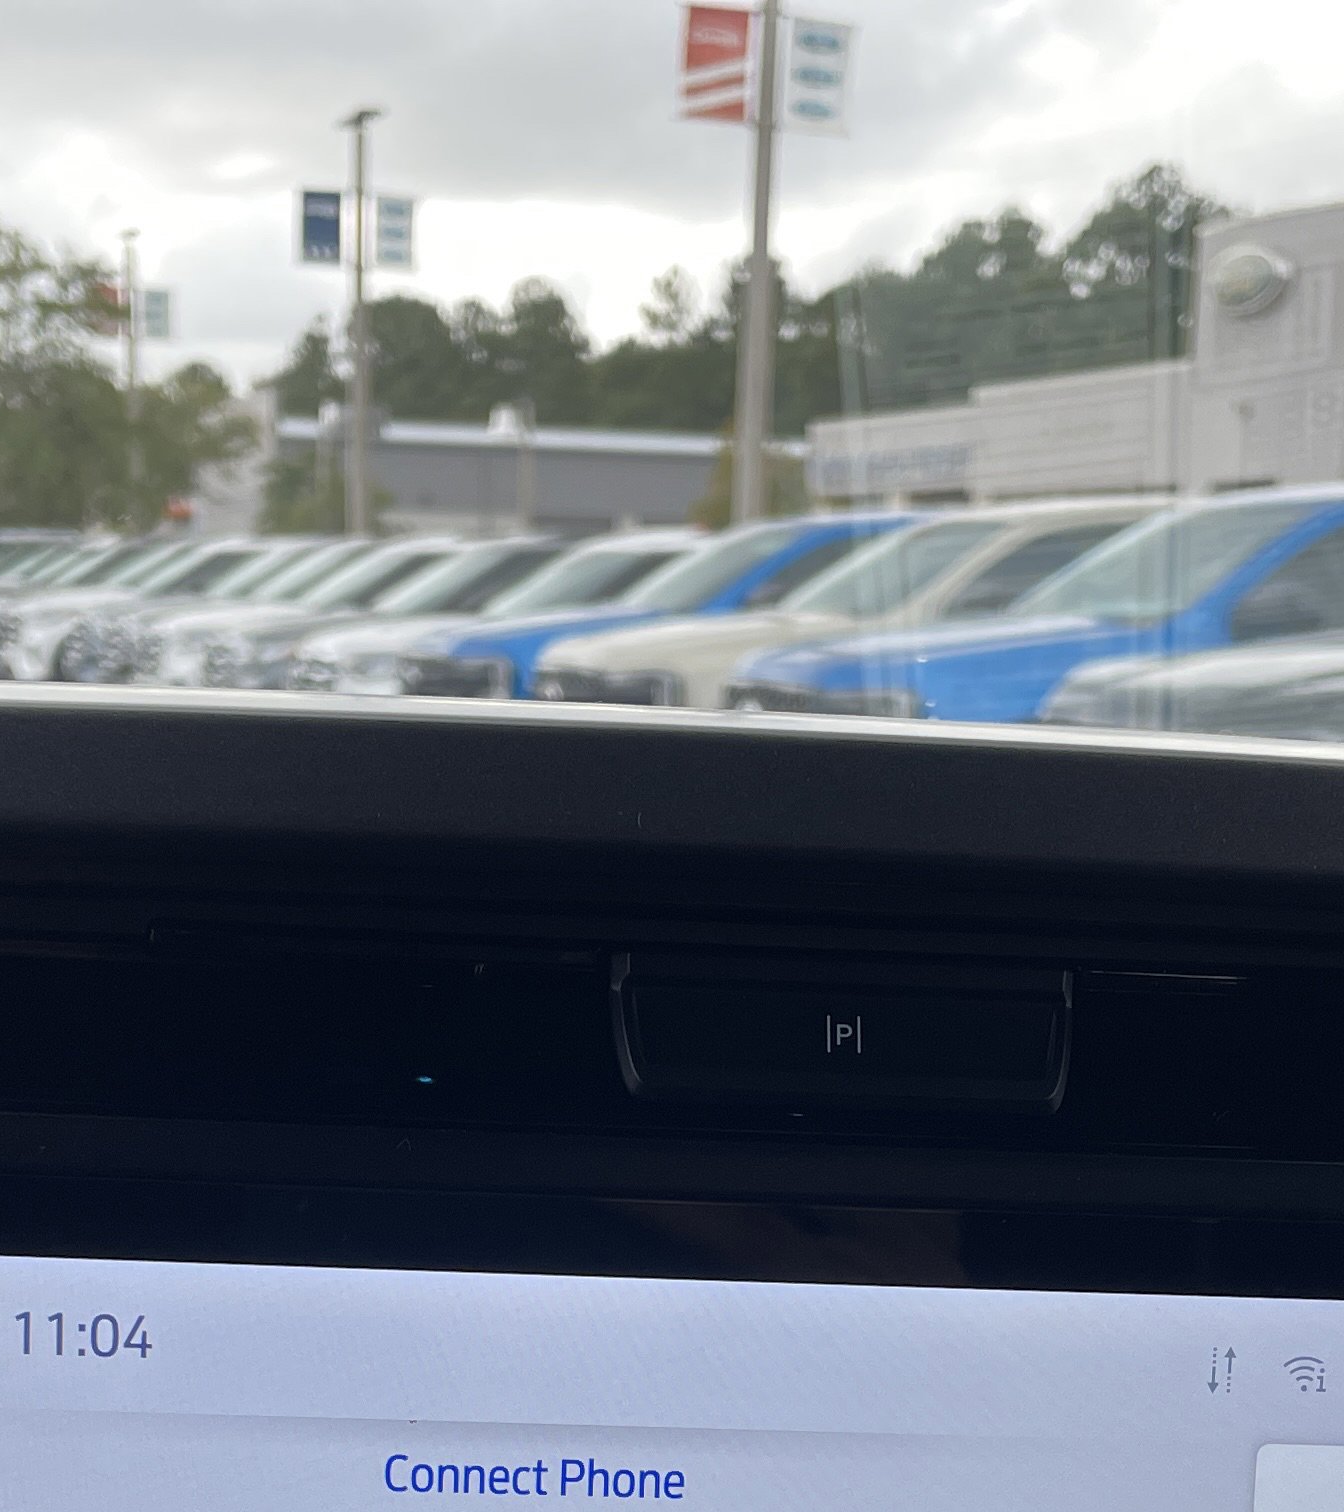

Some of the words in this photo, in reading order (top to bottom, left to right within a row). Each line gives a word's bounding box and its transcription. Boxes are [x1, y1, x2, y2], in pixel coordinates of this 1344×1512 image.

[15, 1311, 153, 1359] 11:04
[384, 1454, 549, 1496] Connect
[560, 1458, 685, 1499] Phone
